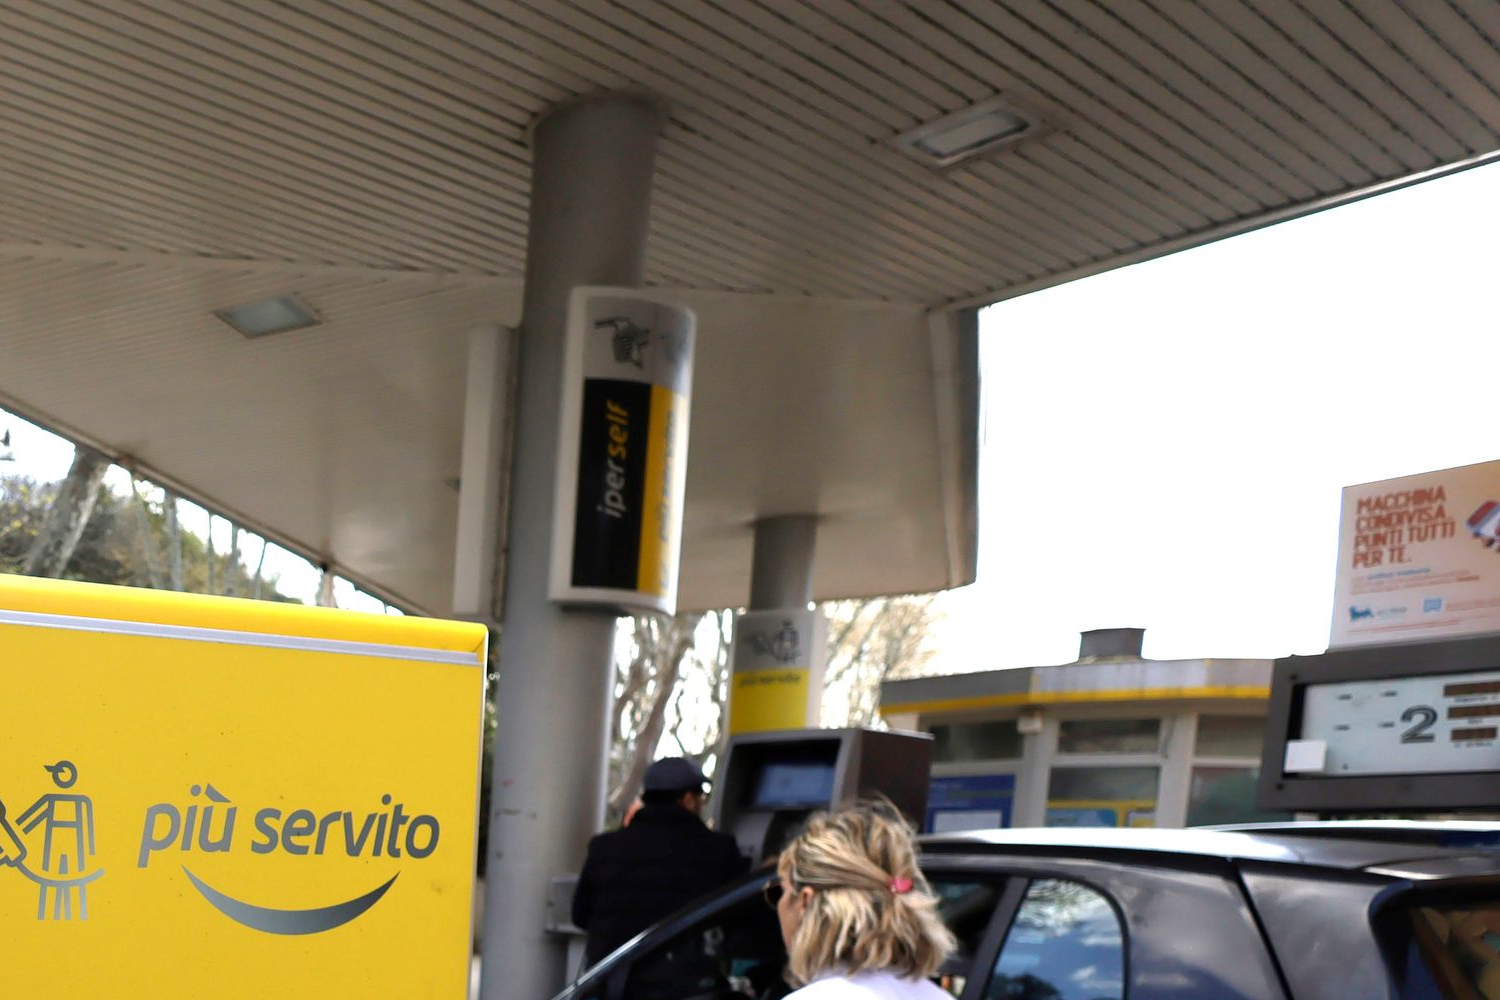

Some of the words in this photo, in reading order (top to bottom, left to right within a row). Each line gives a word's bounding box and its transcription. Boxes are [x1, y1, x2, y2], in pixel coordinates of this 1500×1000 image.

[597, 399, 629, 519] iperself
[1401, 704, 1437, 744] 2
[137, 783, 237, 869] più
[251, 793, 440, 860] servito
